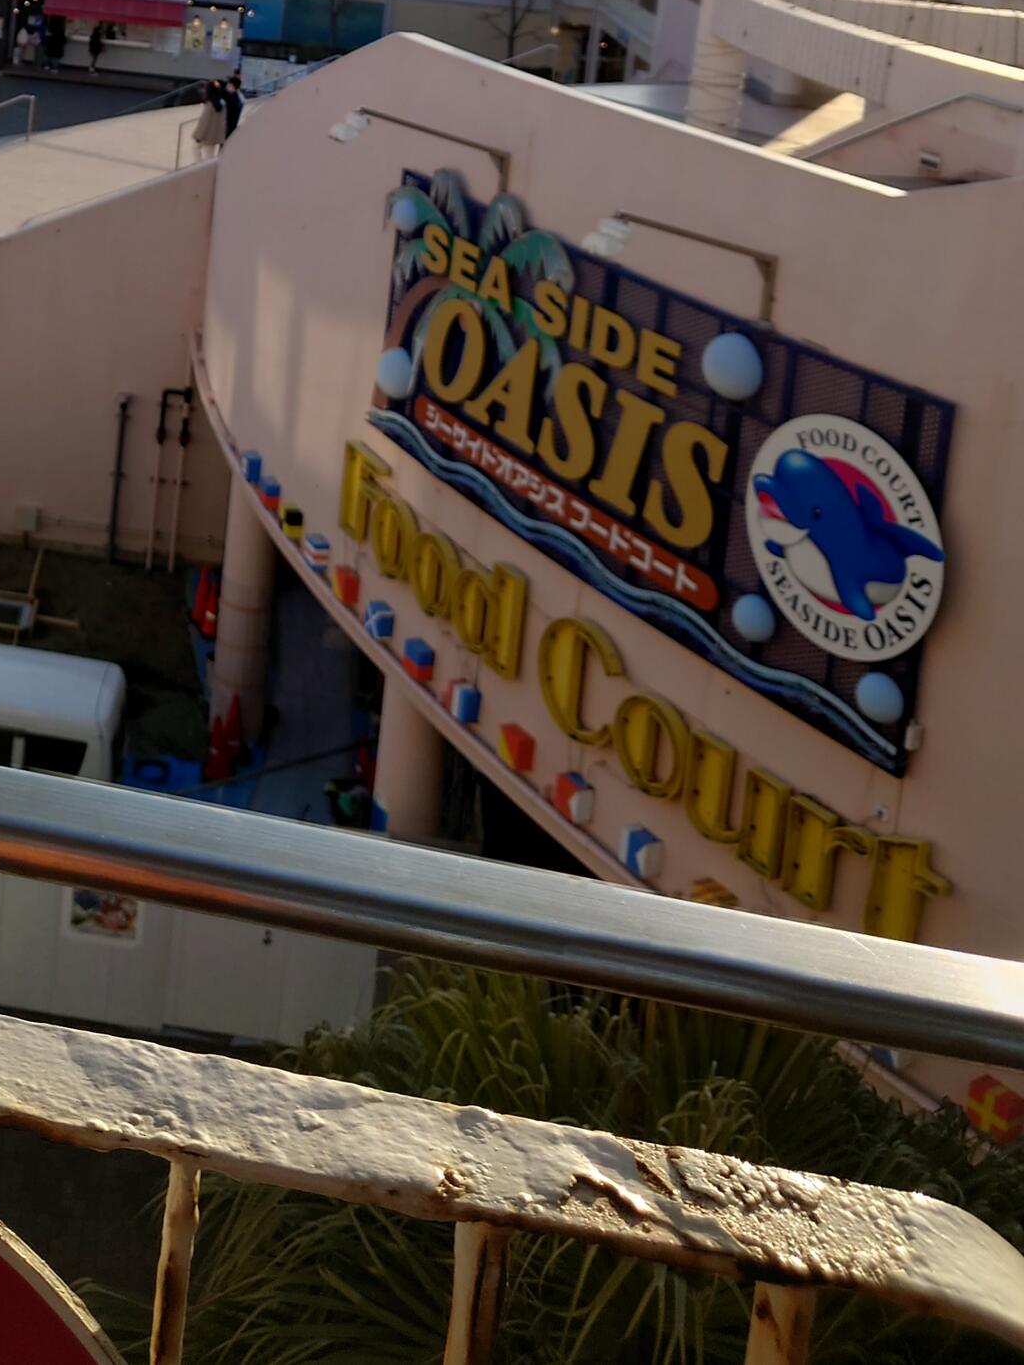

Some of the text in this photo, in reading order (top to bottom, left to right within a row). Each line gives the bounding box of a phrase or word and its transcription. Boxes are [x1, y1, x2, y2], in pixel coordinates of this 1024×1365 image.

[423, 224, 682, 398] SEA SIDE
[423, 298, 728, 548] OASIS
[796, 428, 925, 529] FOOD COURT
[339, 440, 953, 942] Food Court
[766, 561, 933, 652] SEASIDE OASIS
